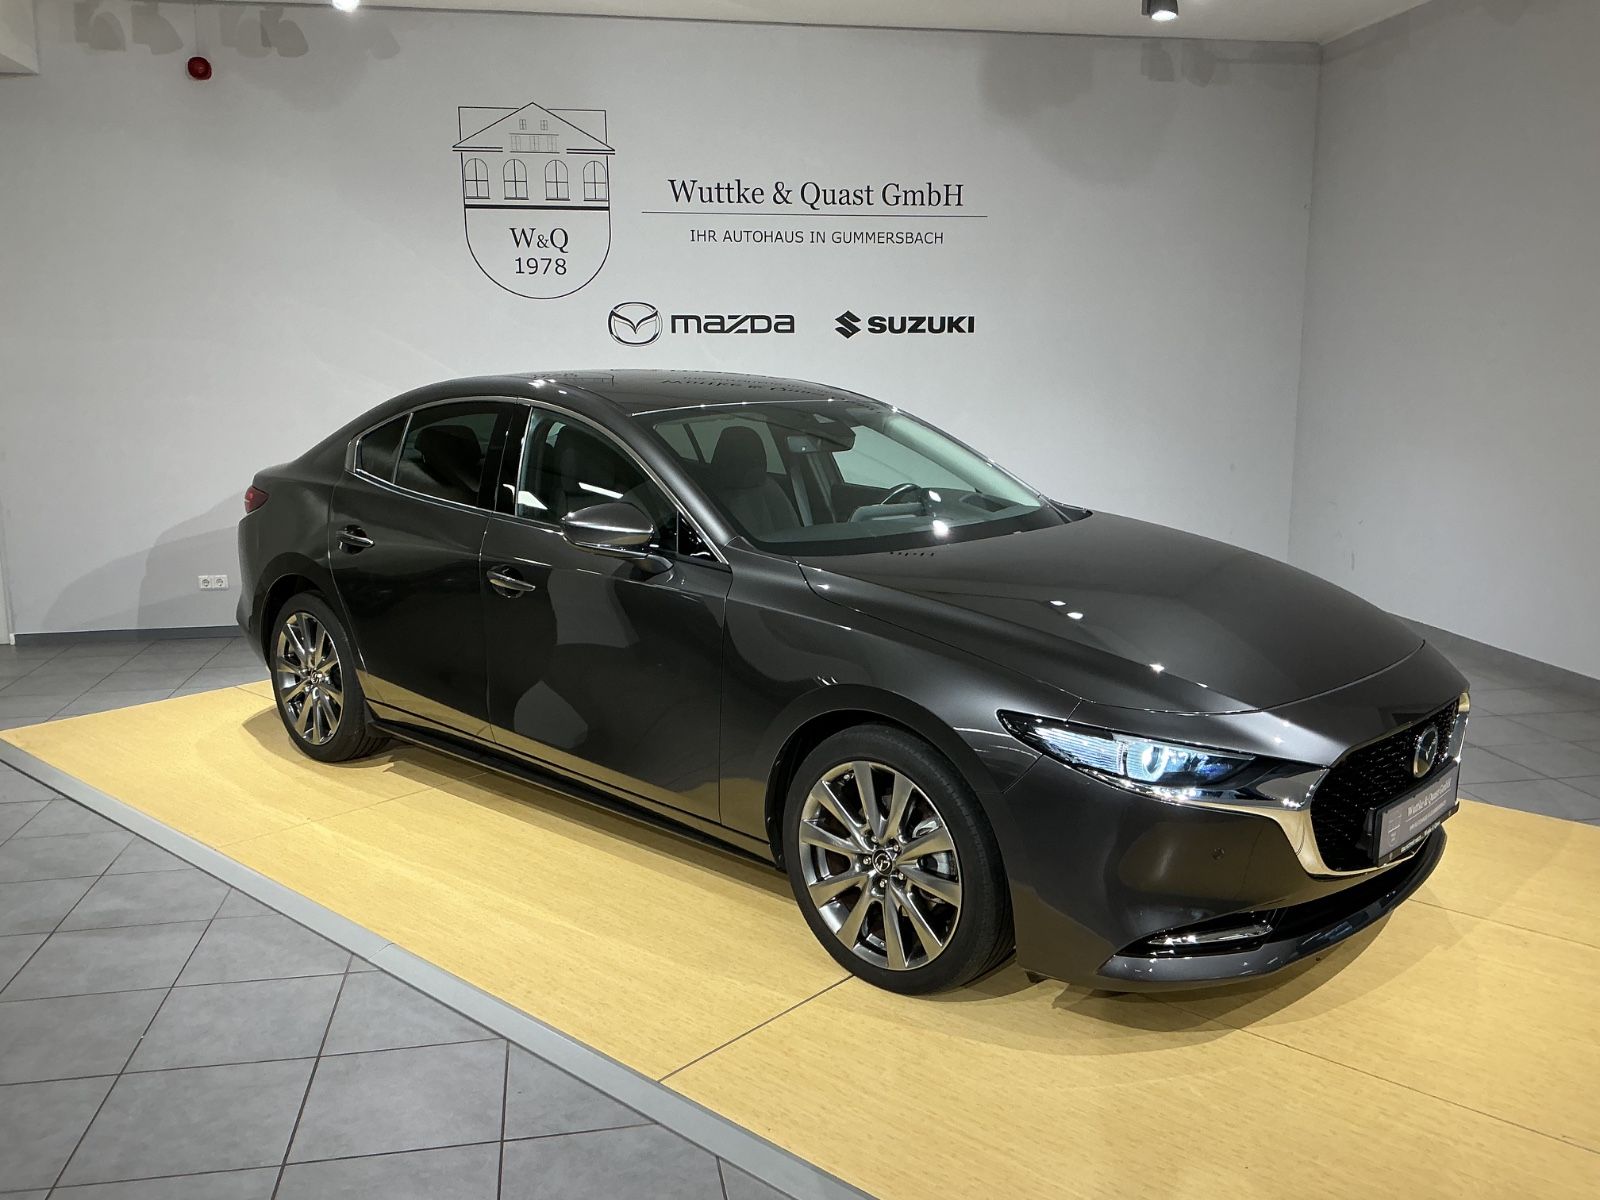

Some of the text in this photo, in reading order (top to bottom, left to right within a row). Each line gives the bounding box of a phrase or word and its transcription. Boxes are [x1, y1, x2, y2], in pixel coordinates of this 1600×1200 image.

[667, 178, 965, 211] Wuttke & Quast GmbH
[508, 227, 569, 254] W&Q
[689, 229, 944, 245] IHR AUTOHAUS IN GUMMERSBACH
[514, 256, 568, 275] 1978
[867, 315, 975, 335] SUZUKI
